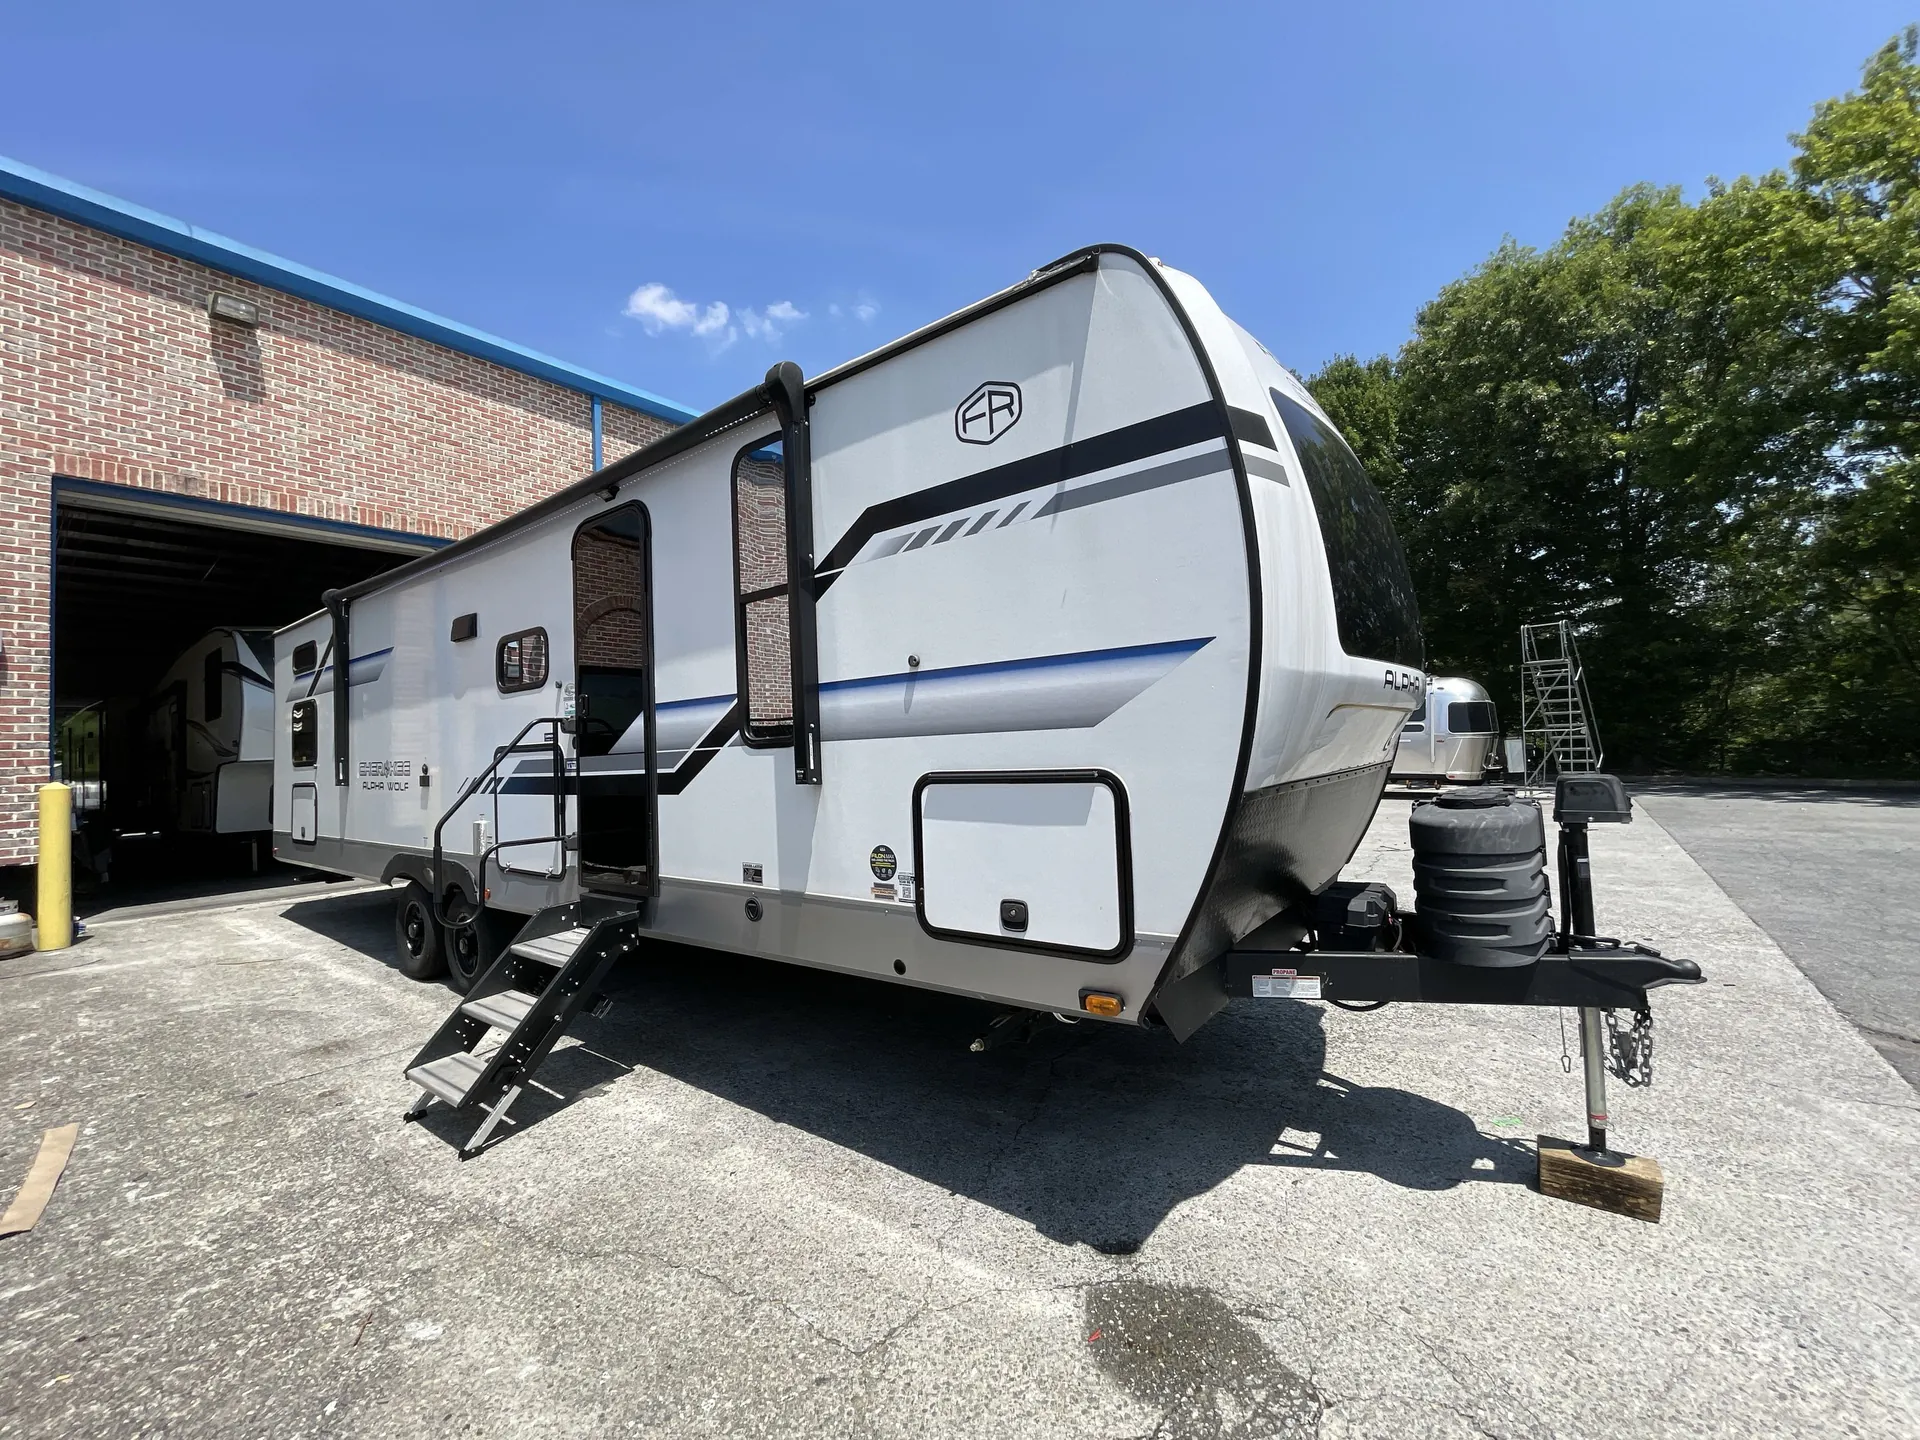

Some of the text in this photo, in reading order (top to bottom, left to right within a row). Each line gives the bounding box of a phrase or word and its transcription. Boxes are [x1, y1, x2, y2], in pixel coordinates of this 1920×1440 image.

[1383, 669, 1420, 693] ALPHA
[362, 781, 409, 791] ALPHA WOLF
